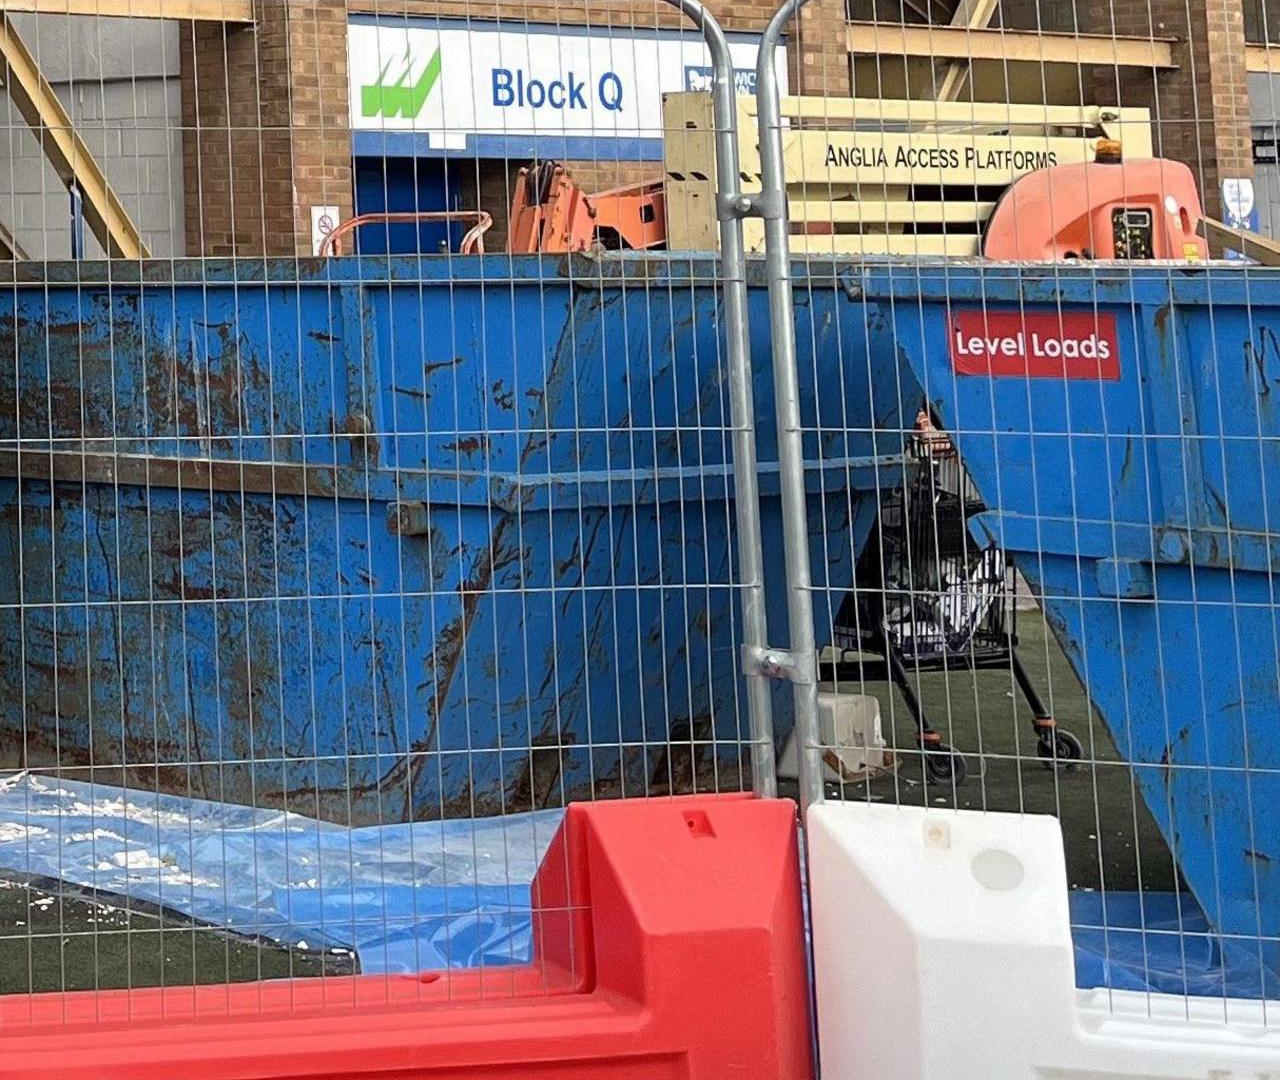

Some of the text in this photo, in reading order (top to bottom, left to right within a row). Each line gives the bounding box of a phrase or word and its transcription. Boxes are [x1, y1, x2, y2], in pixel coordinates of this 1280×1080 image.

[491, 68, 624, 113] Block Q
[824, 144, 1057, 170] ANGLIA ACCESS PLATFORMS
[956, 331, 1110, 359] Level Loads
